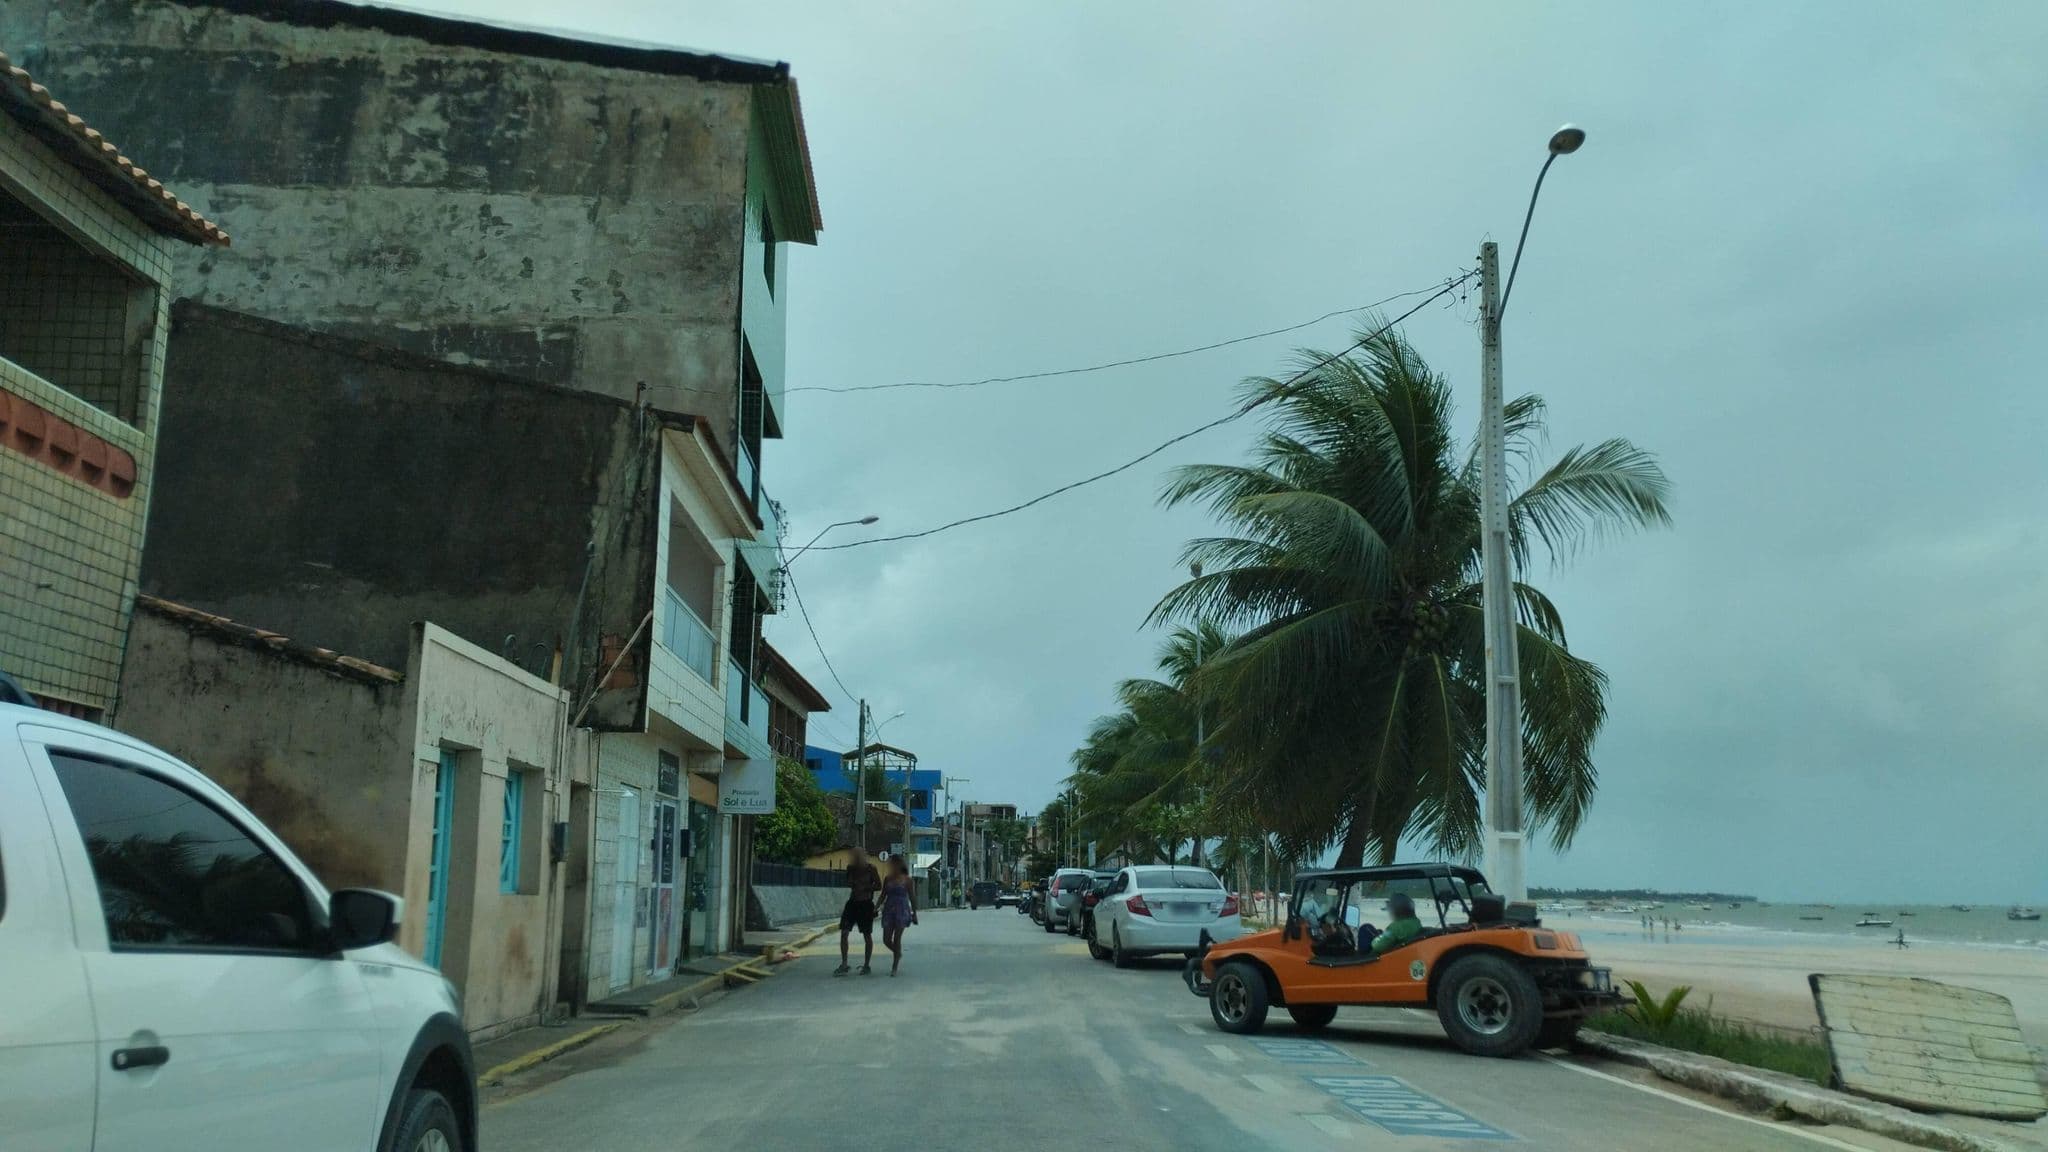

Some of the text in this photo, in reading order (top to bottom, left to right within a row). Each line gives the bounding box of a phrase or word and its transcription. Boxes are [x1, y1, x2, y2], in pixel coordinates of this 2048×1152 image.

[723, 797, 768, 807] Sol e Lua
[1311, 1078, 1498, 1134] BUGGY
